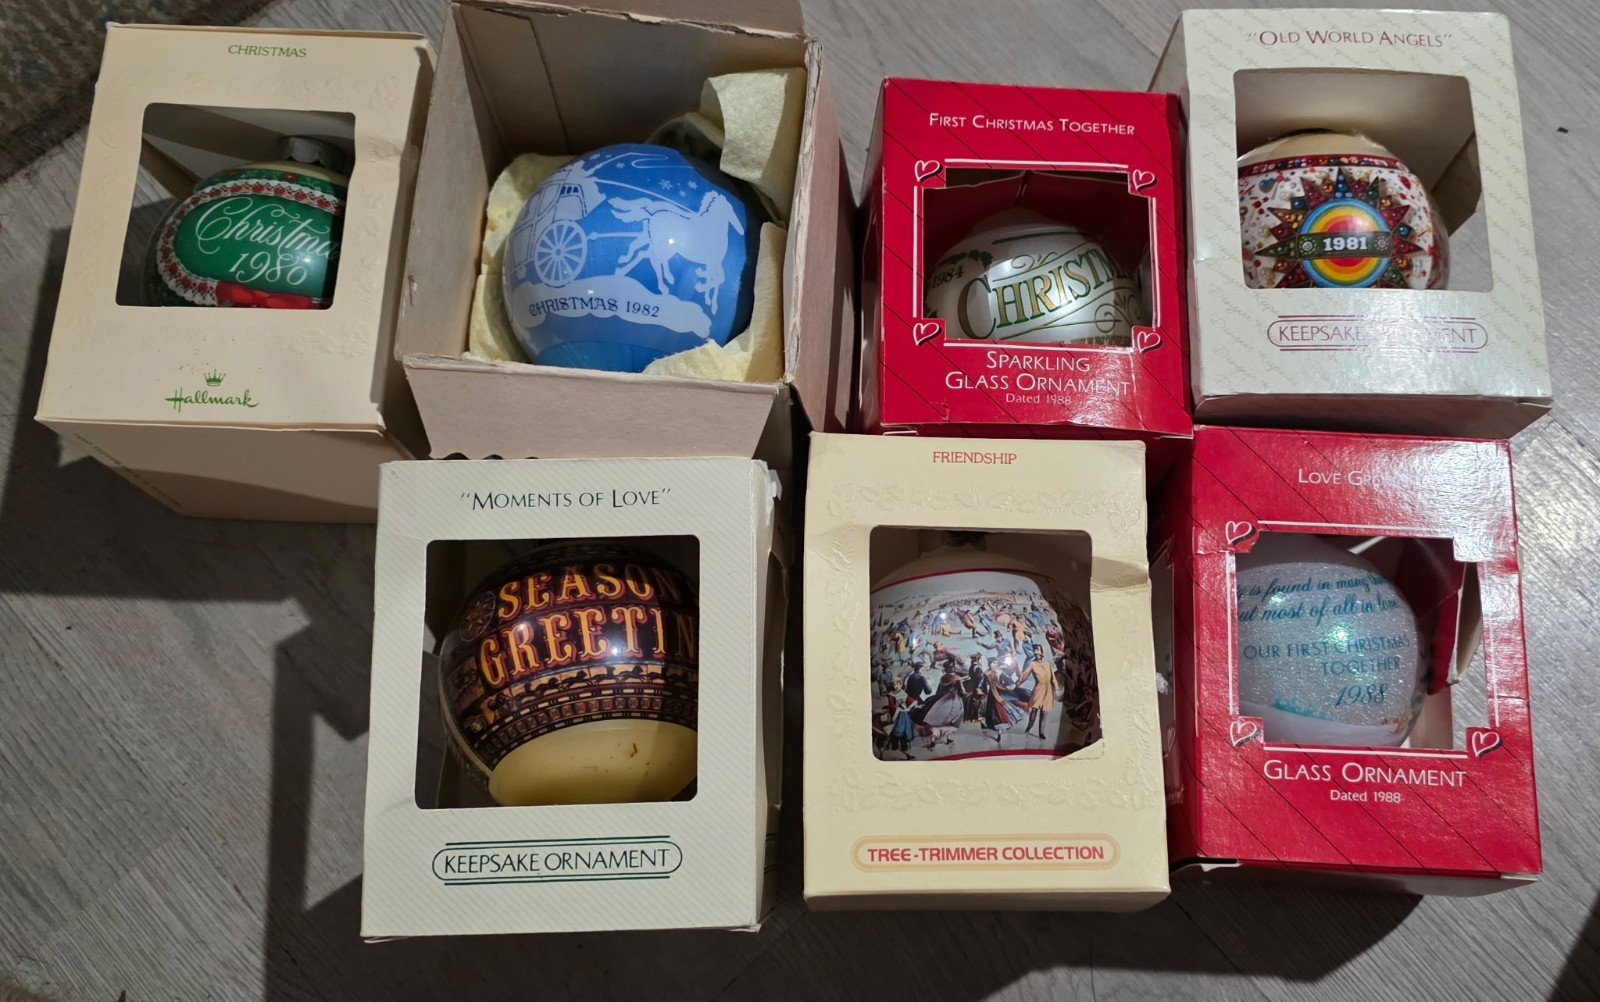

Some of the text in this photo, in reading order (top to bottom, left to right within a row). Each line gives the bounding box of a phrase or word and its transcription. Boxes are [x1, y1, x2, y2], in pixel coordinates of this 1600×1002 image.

[1306, 30, 1373, 45] WORLD
[228, 44, 307, 59] CHRISTMAS
[929, 113, 1135, 135] FIRST CHRISTMAS TOGETHER
[1323, 236, 1368, 251] 1981
[229, 251, 308, 286] 1980
[528, 297, 660, 318] CHRISTMAS 1982
[1279, 326, 1365, 341] KEEPSAKE
[987, 351, 1090, 372] SPARKLING
[945, 371, 1130, 396] GLASS ORNAMENT
[165, 389, 260, 412] Hallmark
[1005, 393, 1072, 405] Dated 1988
[932, 451, 1017, 465] FRIENDSHIP
[1298, 468, 1341, 485] LOVE
[578, 492, 604, 508] OF
[1261, 577, 1312, 602] found
[1317, 581, 1331, 591] in
[1261, 602, 1304, 621] most
[1309, 596, 1330, 626] of
[1333, 596, 1359, 616] all
[1361, 600, 1374, 612] in
[1244, 633, 1410, 660] OUR FIRST CHRISTMAS
[1320, 657, 1401, 676] TOGETHER
[1335, 683, 1388, 708] 1988
[1263, 759, 1467, 788] GLASS ORNAMENT
[1330, 789, 1402, 803] Dated 1988
[445, 848, 671, 874] KEEPSAKE ORNAMENT
[867, 846, 1104, 862] TREE-TRIMMER COLLECTION
